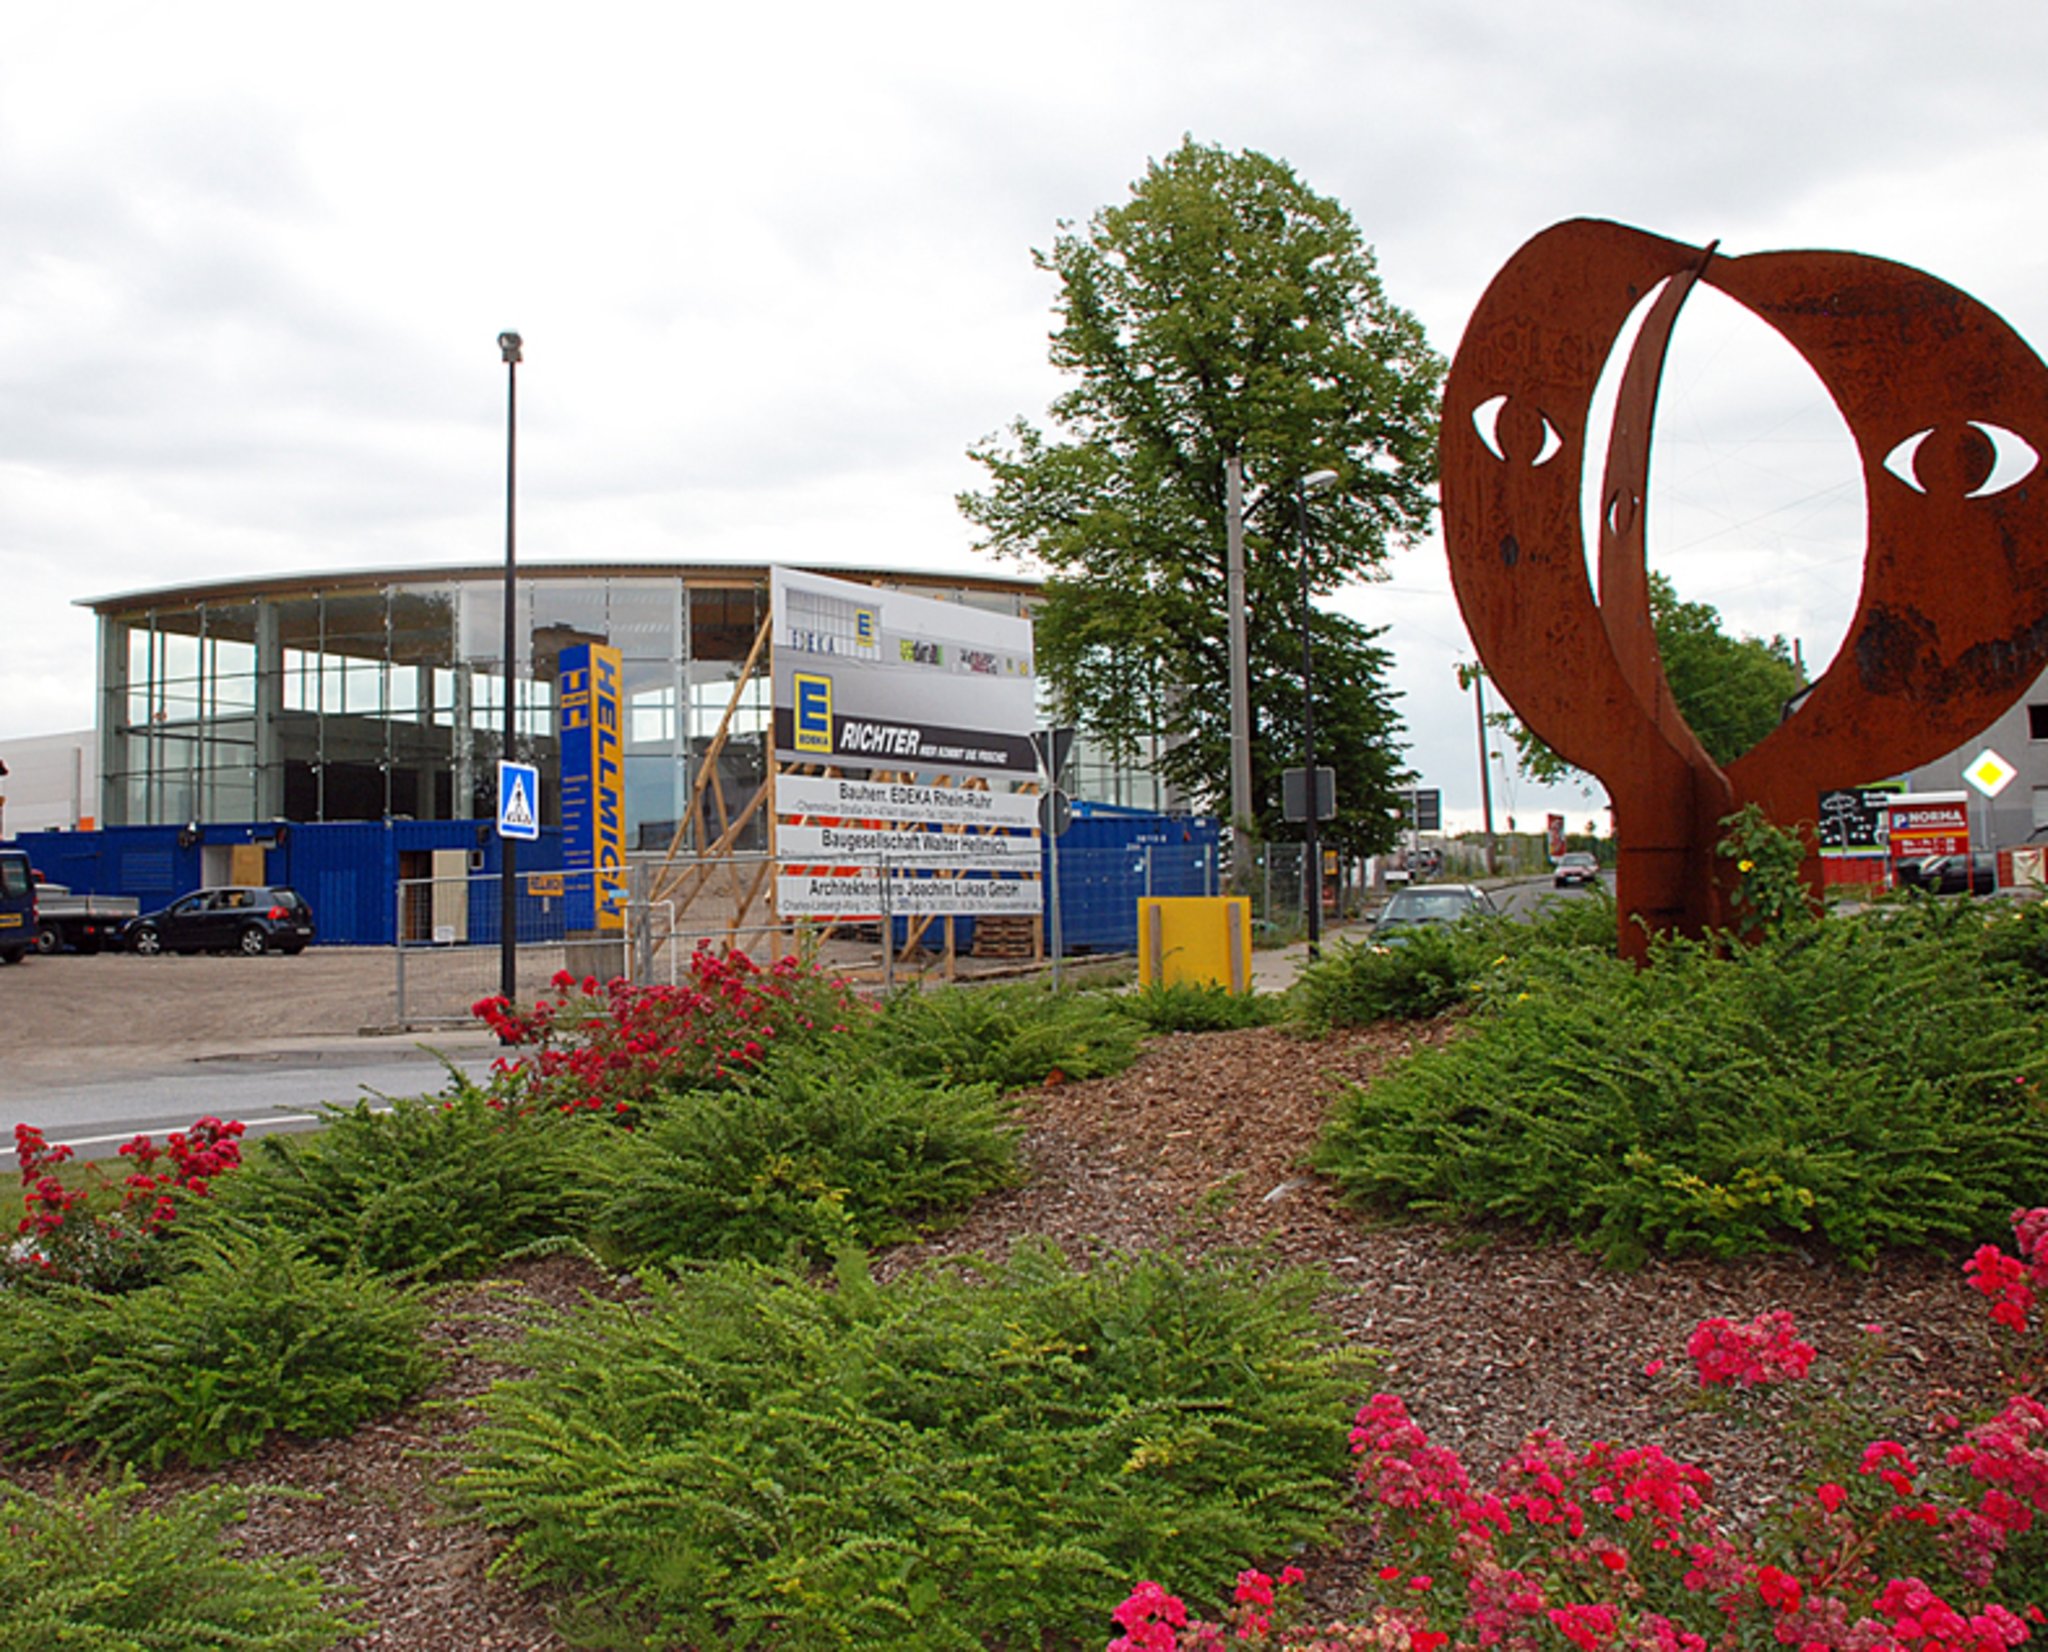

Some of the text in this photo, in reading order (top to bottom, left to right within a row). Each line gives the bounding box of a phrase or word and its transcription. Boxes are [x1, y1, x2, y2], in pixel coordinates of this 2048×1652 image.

[800, 733, 829, 746] EDEKA
[840, 721, 921, 756] RICHTER
[597, 657, 621, 918] HELLMICH
[890, 785, 932, 805] EDEKA
[933, 789, 993, 809] Rhein-Ruhr
[1909, 809, 1963, 823] NORMA
[821, 828, 1008, 854] Baugesellschaft Walter Hellmich
[905, 880, 953, 897] Joachim
[954, 881, 987, 897] Lukas
